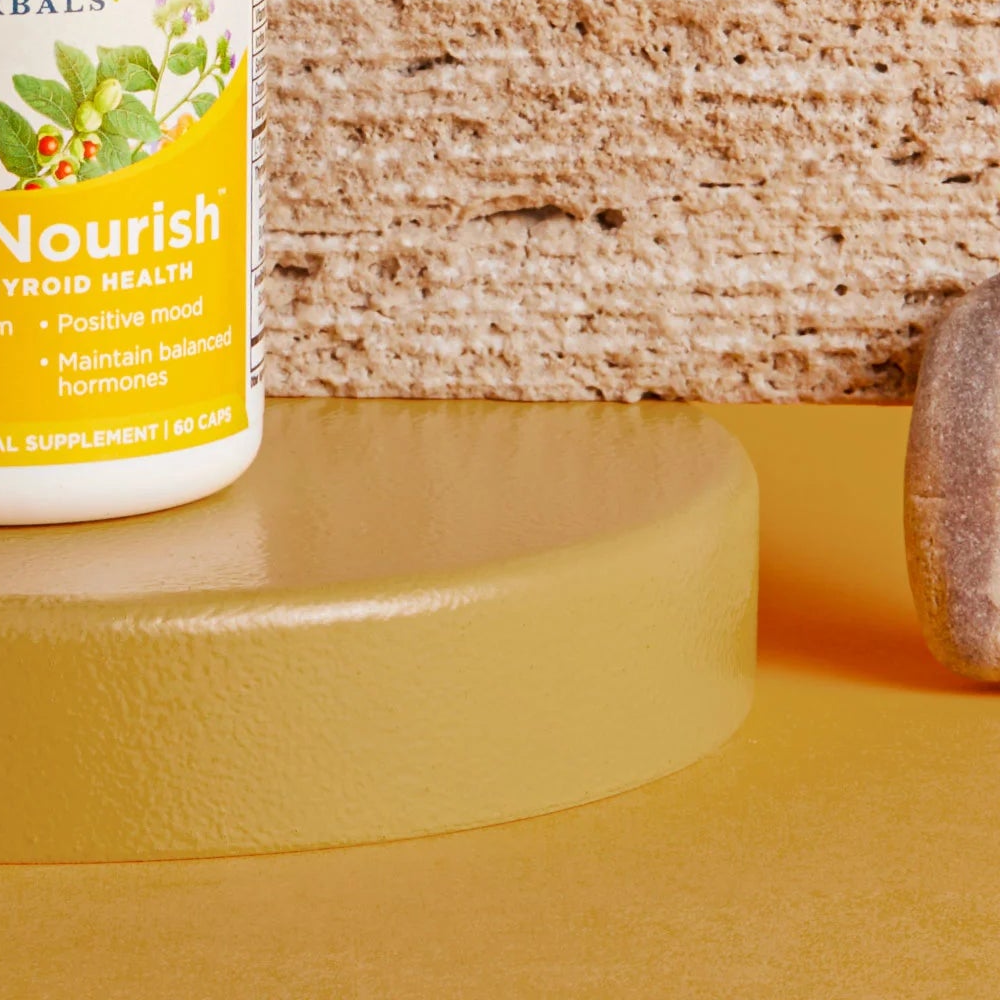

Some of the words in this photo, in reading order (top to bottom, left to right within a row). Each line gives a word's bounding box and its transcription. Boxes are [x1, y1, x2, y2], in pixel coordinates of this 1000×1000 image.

[102, 260, 193, 291] HEALTH
[58, 309, 145, 333] Positive
[151, 296, 203, 324] mood
[58, 345, 152, 372] Maintain
[159, 325, 232, 361] balanced
[58, 370, 168, 396] hormones
[25, 424, 159, 452] SUPPLEMENT
[173, 419, 194, 436] 60
[198, 406, 232, 430] CAPS
